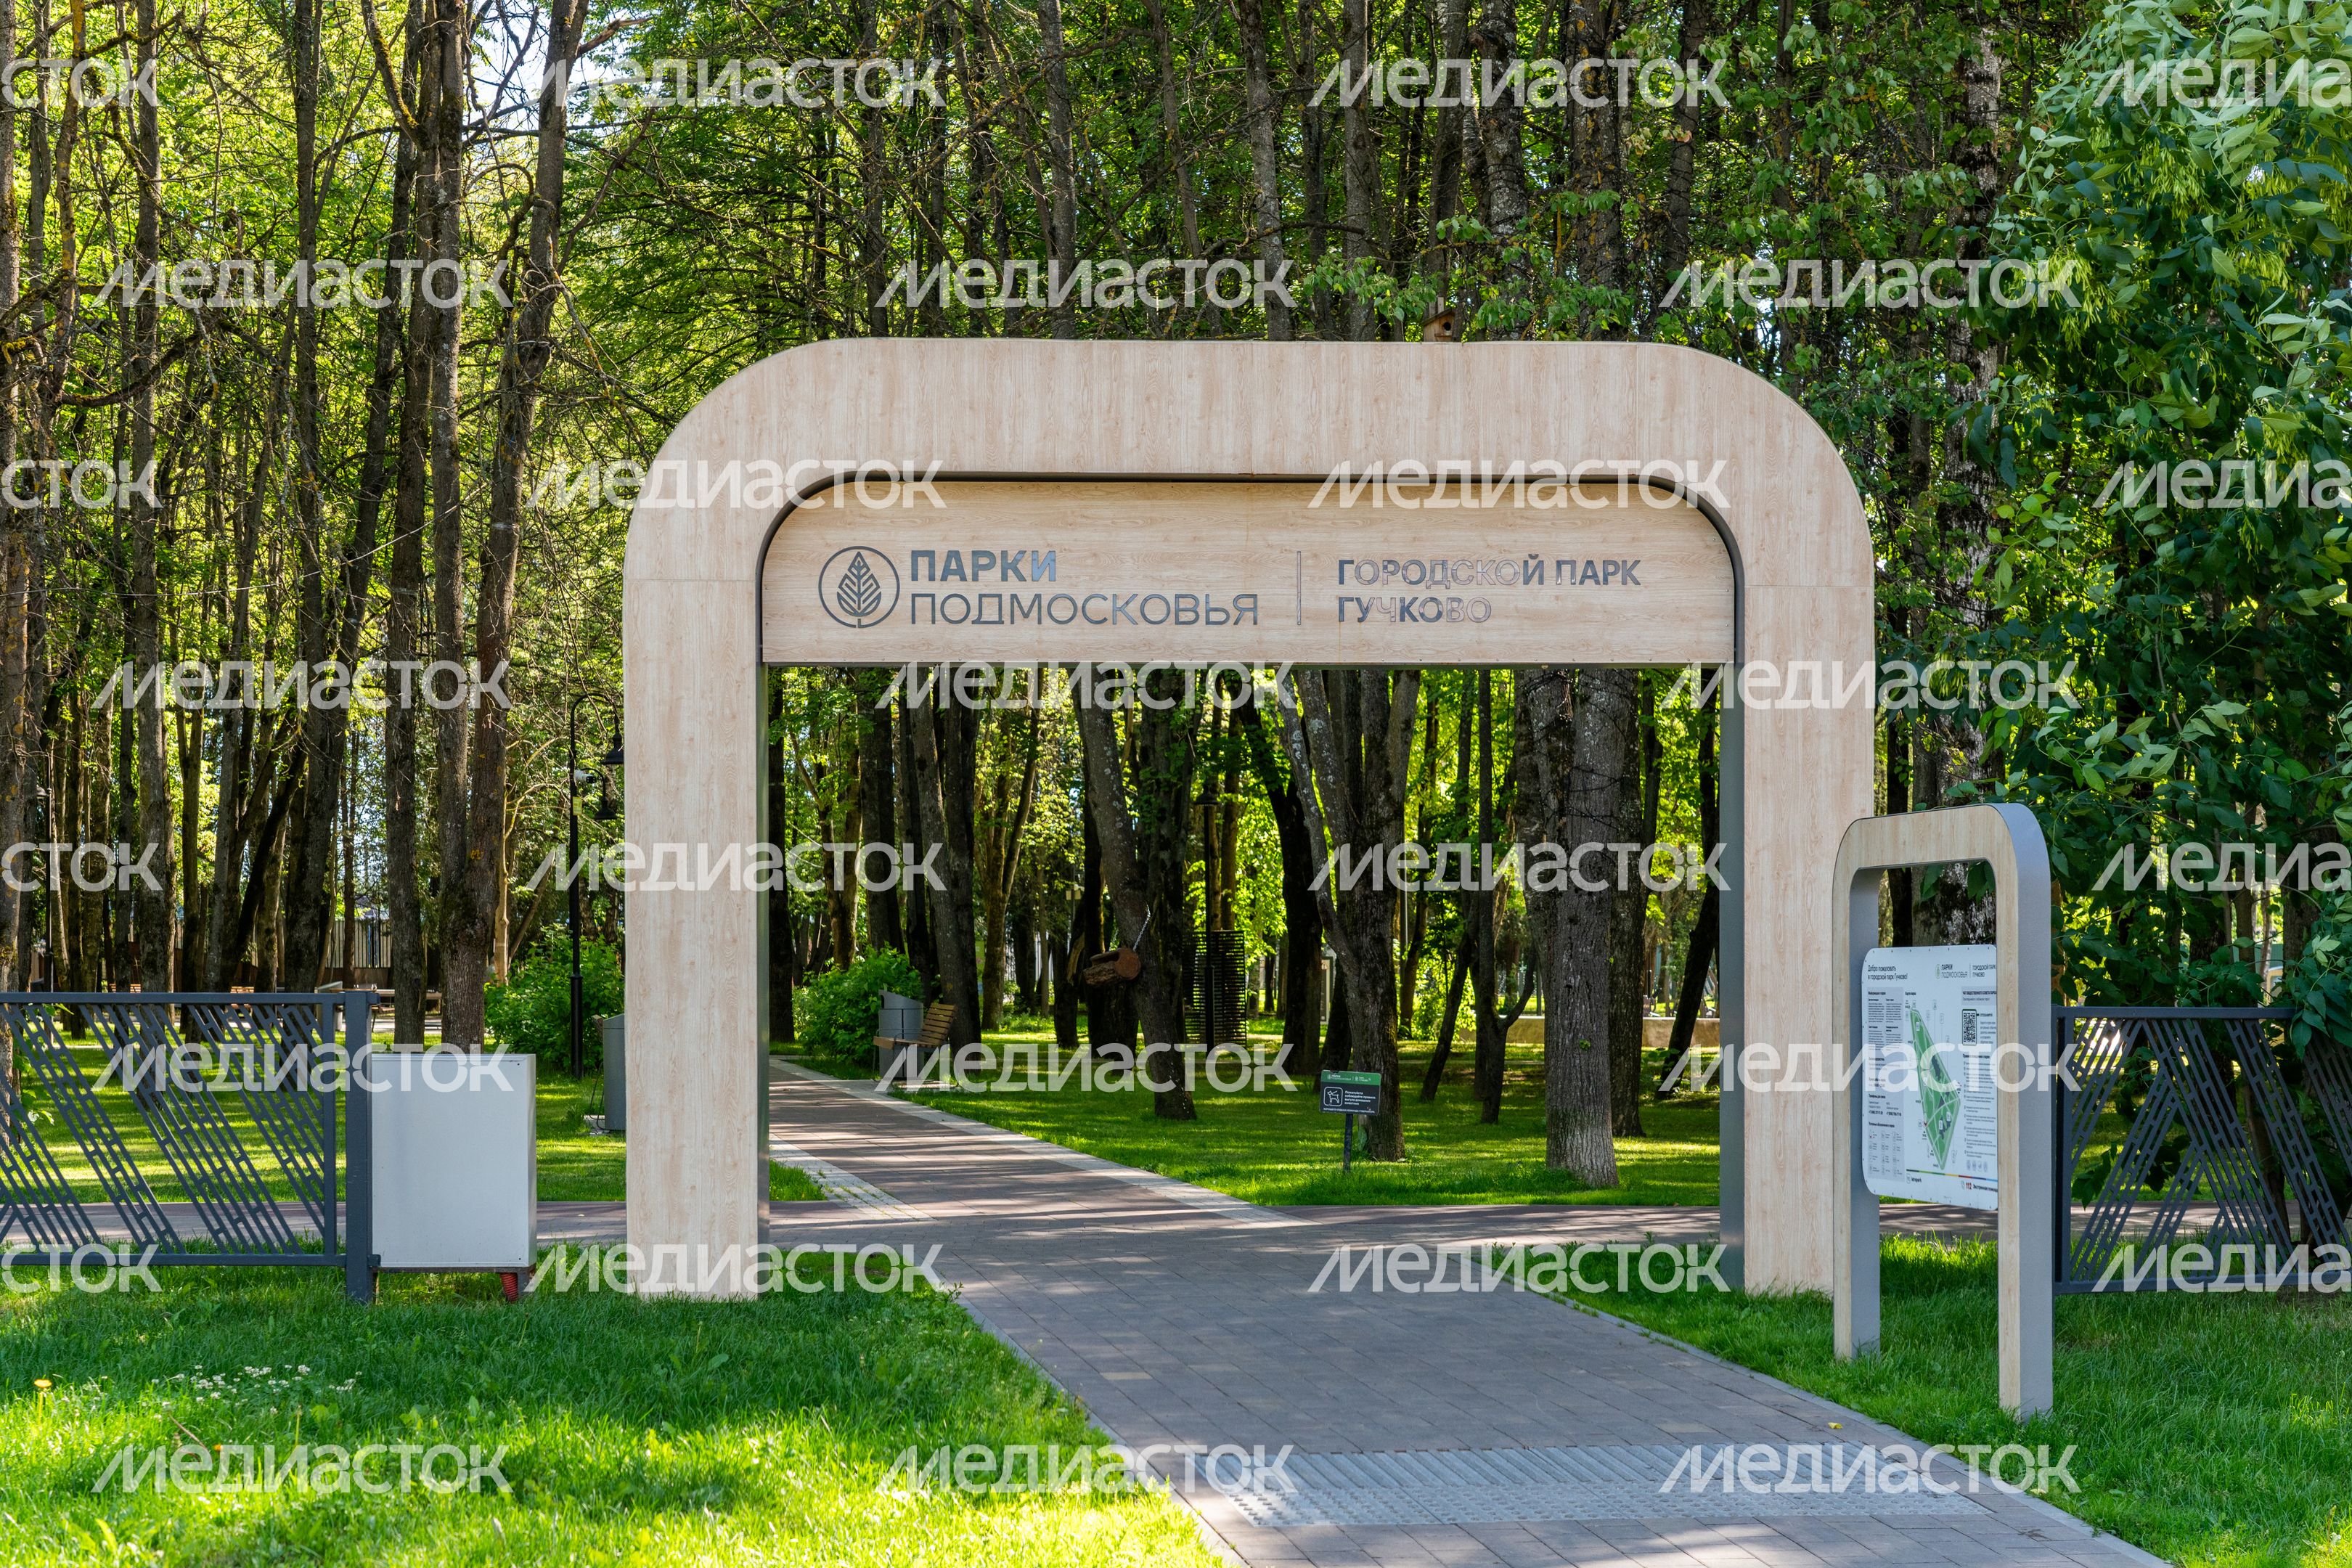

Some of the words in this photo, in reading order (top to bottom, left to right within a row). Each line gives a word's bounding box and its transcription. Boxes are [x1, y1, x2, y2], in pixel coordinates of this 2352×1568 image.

[911, 550, 1056, 581] ПАРКИ
[1338, 553, 1544, 589] ГОРОДСКОЙ
[1556, 560, 1641, 585] ПАРК
[911, 593, 1258, 625] ПОДМОСКОВЬЯ
[1338, 596, 1492, 623] ГУЧКОВО
